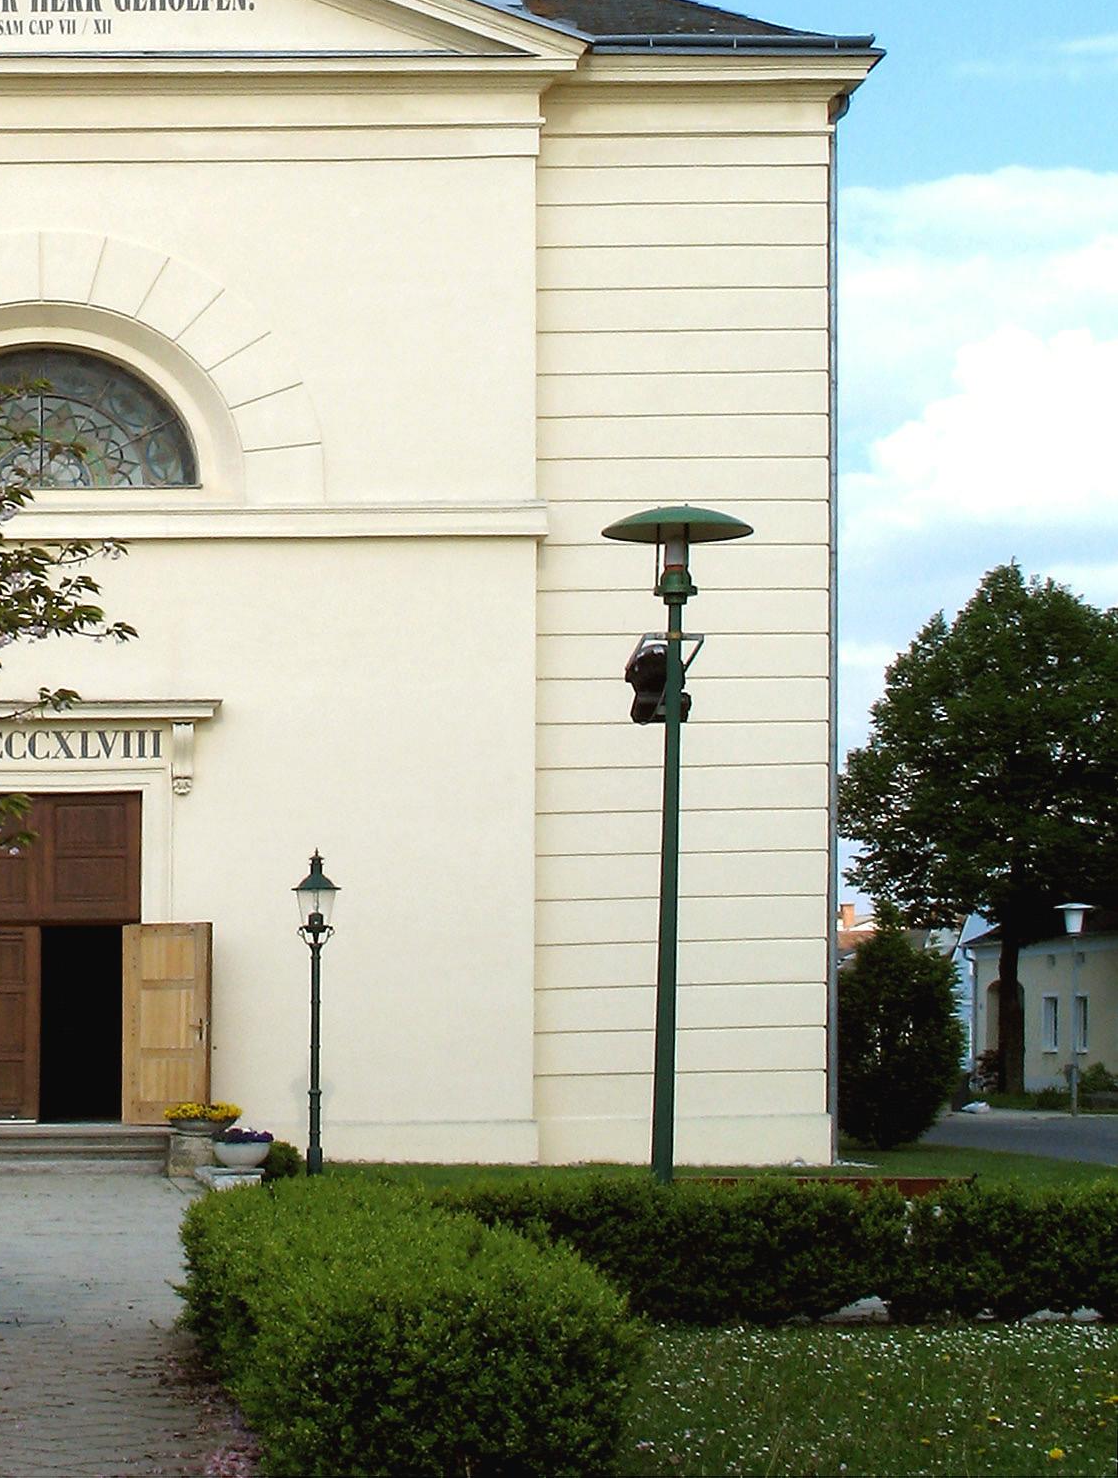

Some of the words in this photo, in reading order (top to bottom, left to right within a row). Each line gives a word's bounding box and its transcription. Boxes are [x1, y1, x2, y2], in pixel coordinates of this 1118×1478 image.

[28, 19, 54, 35] CAP
[59, 18, 77, 35] VII
[93, 18, 113, 35] XII
